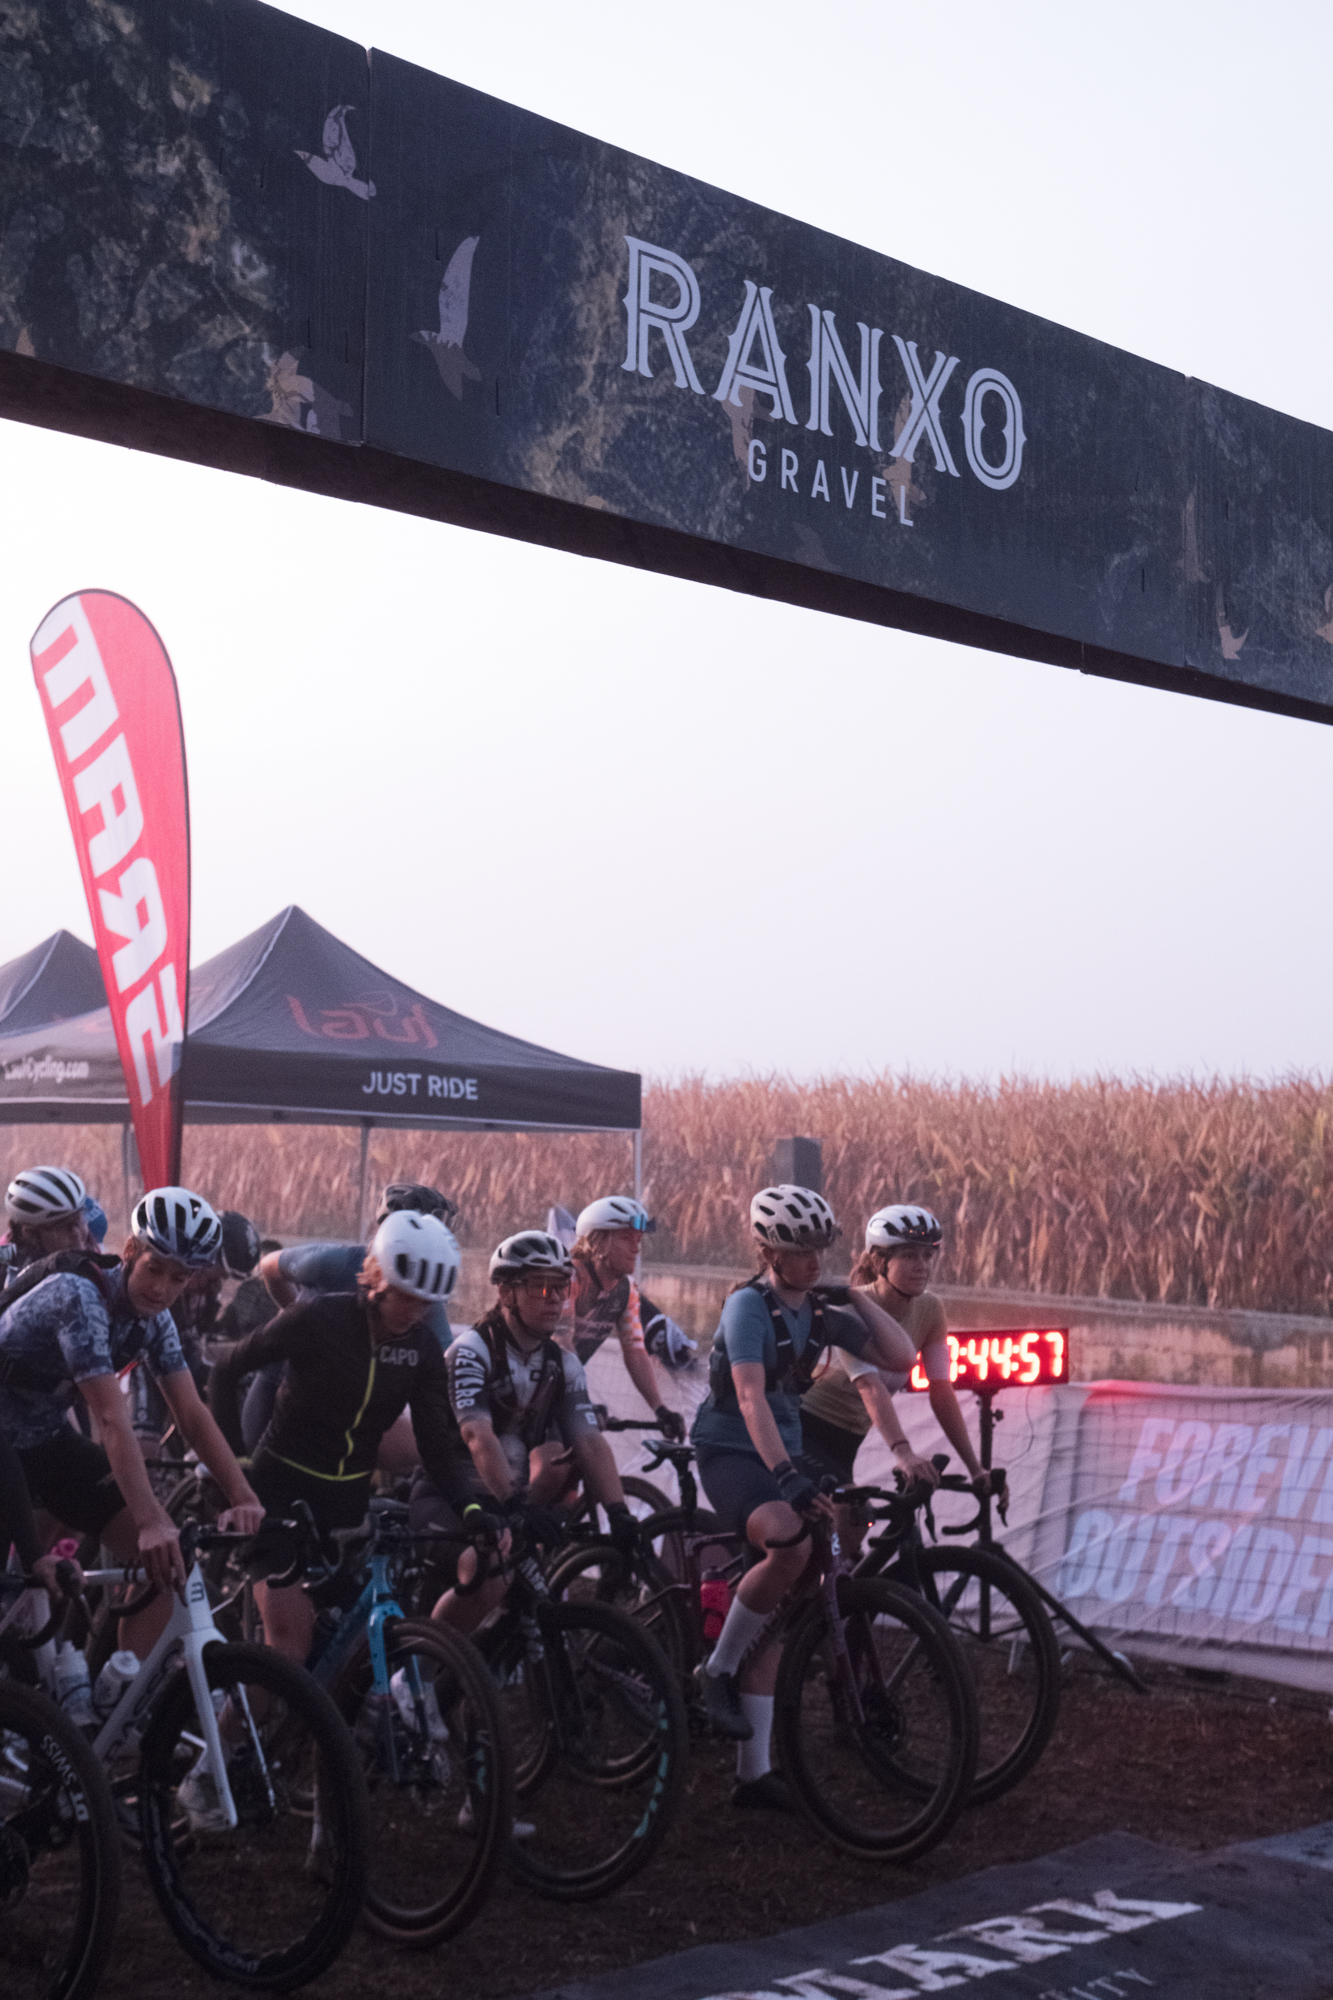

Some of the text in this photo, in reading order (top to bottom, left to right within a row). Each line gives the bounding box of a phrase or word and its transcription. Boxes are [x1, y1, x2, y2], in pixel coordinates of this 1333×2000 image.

[621, 235, 1027, 490] RANXO
[748, 439, 914, 527] GRAVEL
[362, 1071, 478, 1101] JUST RIDE
[380, 1346, 419, 1366] CAPO
[41, 1734, 90, 1822] DT SWISS
